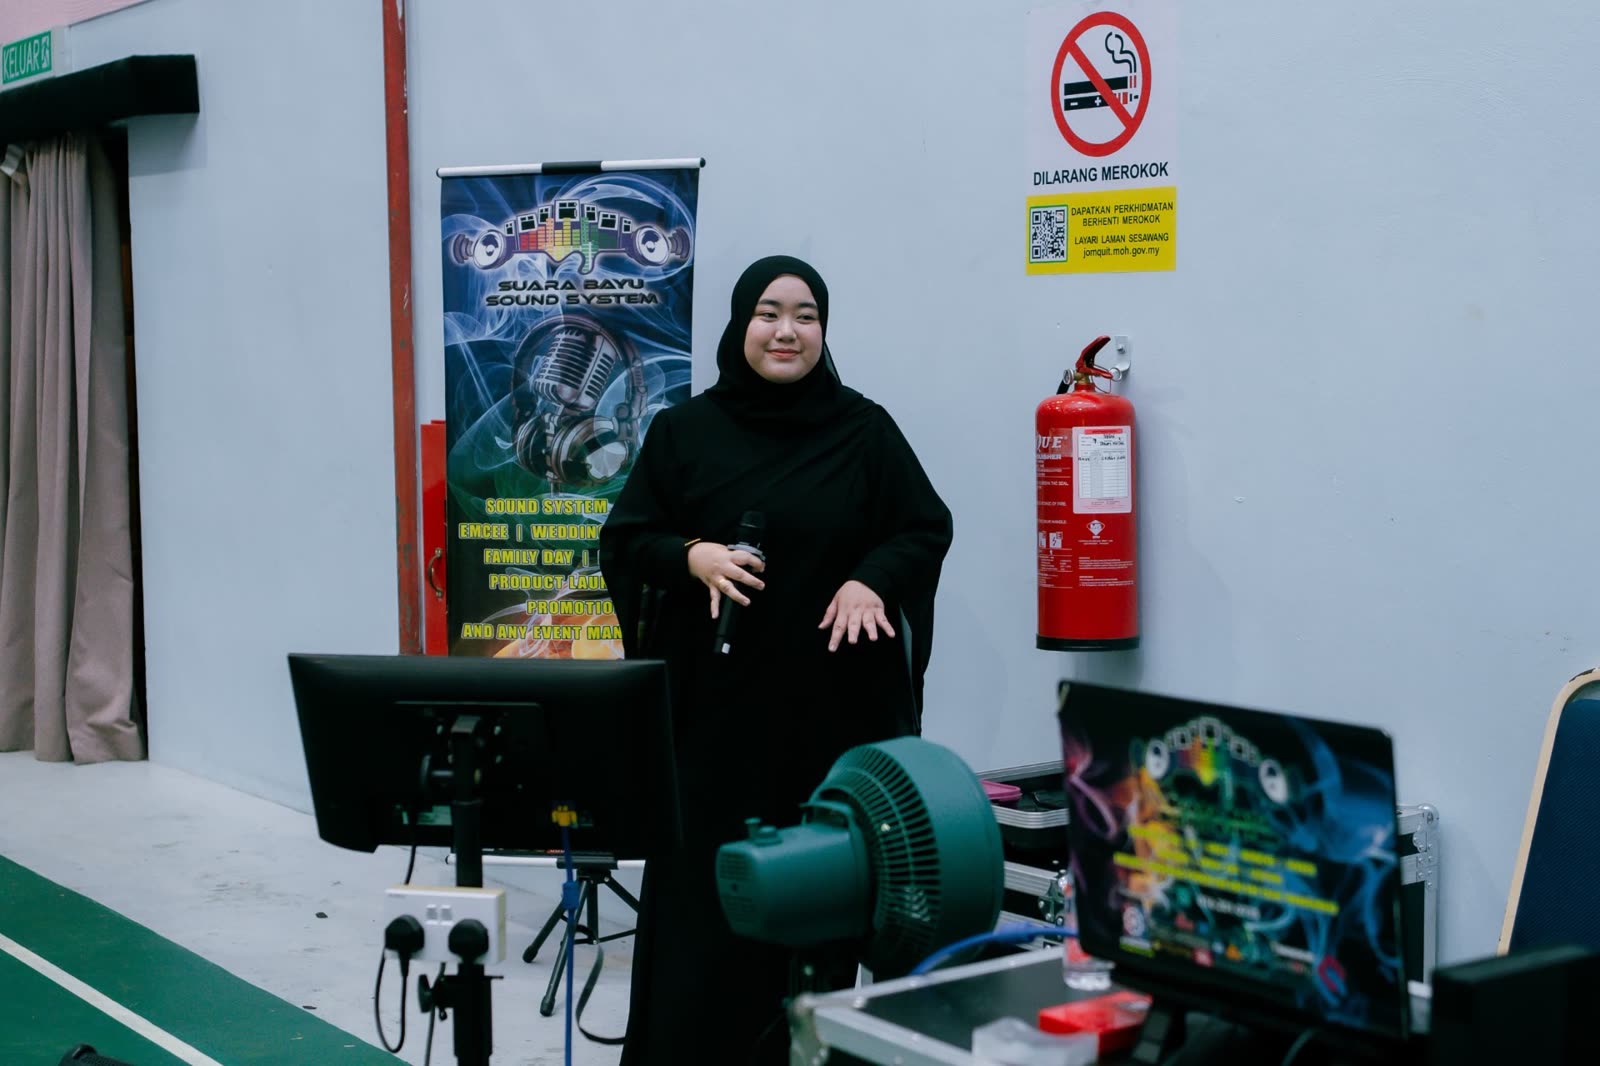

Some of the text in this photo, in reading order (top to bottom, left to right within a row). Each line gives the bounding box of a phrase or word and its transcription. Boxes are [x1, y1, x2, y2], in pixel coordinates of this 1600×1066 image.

[4, 39, 40, 80] KELUAR
[1033, 161, 1169, 186] DILARANG MEROKOK
[1071, 202, 1174, 216] DAPATKAN PERKHIDMATAN
[1082, 214, 1161, 227] BERHENTI MEROKOK
[1074, 232, 1169, 245] LAYARI LAMAN SESAWANG
[1083, 247, 1160, 259] jomquit.moh.gov.my
[498, 278, 645, 292] SUARA BAYU
[485, 293, 659, 307] SOUND SYSTEM
[486, 498, 608, 514] SOUND SYSTEM
[459, 523, 509, 539] EMCEE
[531, 524, 603, 540] WEDDIN
[484, 549, 539, 565] FAMILY
[542, 549, 574, 565] DAY
[489, 574, 565, 590] PRODUCT
[526, 600, 614, 615] PROMOTIO
[461, 623, 622, 640] AND ANY EVENT MAN
